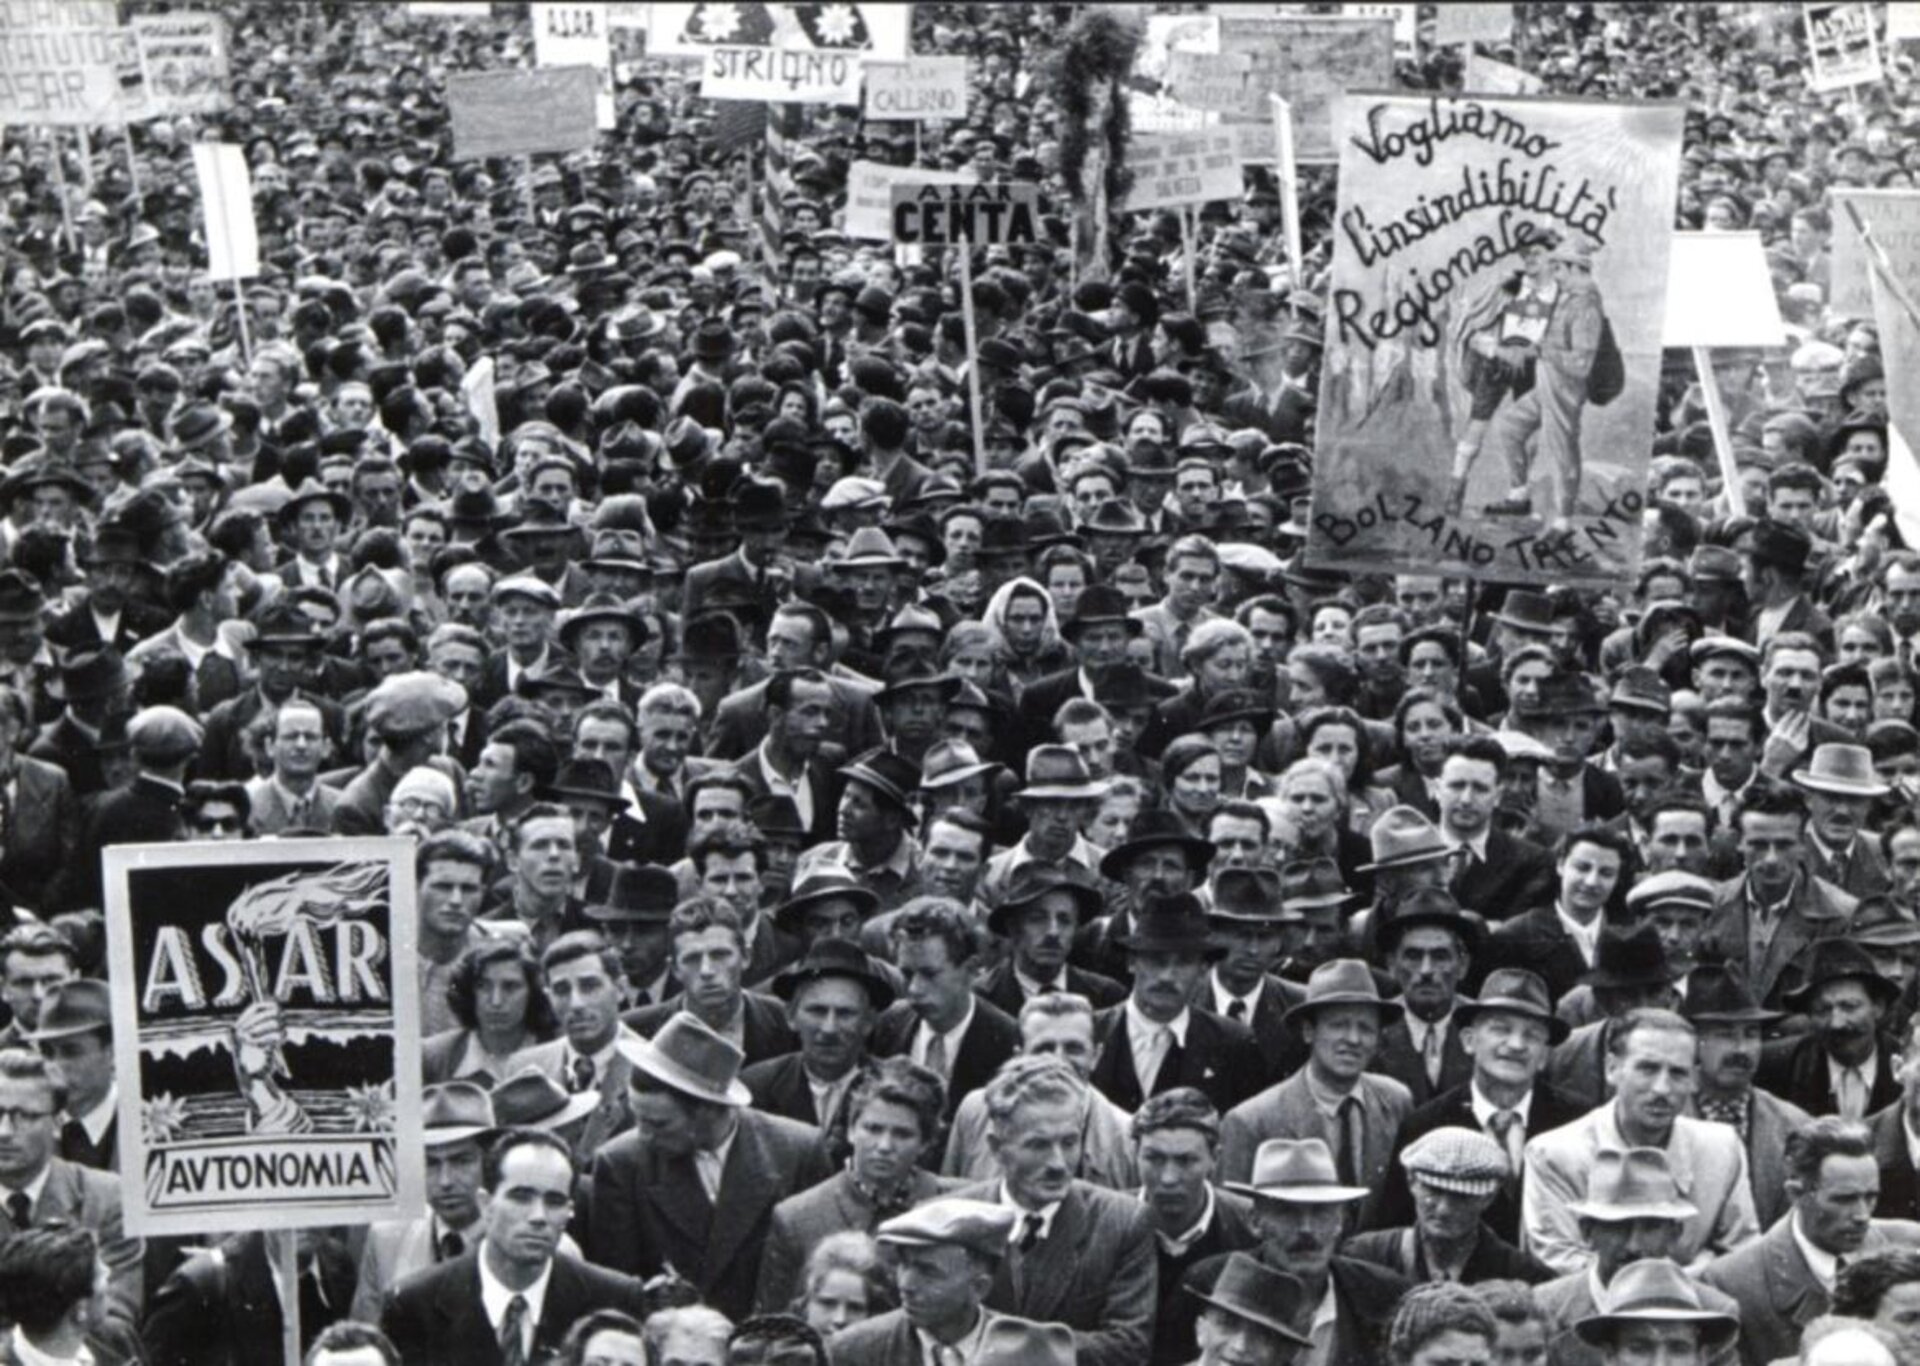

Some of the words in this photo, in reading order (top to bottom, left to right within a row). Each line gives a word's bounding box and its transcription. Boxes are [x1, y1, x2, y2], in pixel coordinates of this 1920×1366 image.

[1350, 98, 1562, 167] Vogliamo
[917, 184, 1011, 201] ASAR
[893, 202, 1036, 244] CENTA
[1333, 210, 1556, 348] Regionale
[1505, 489, 1644, 571] TRENTO
[165, 1151, 372, 1195] AVTONOMIA
